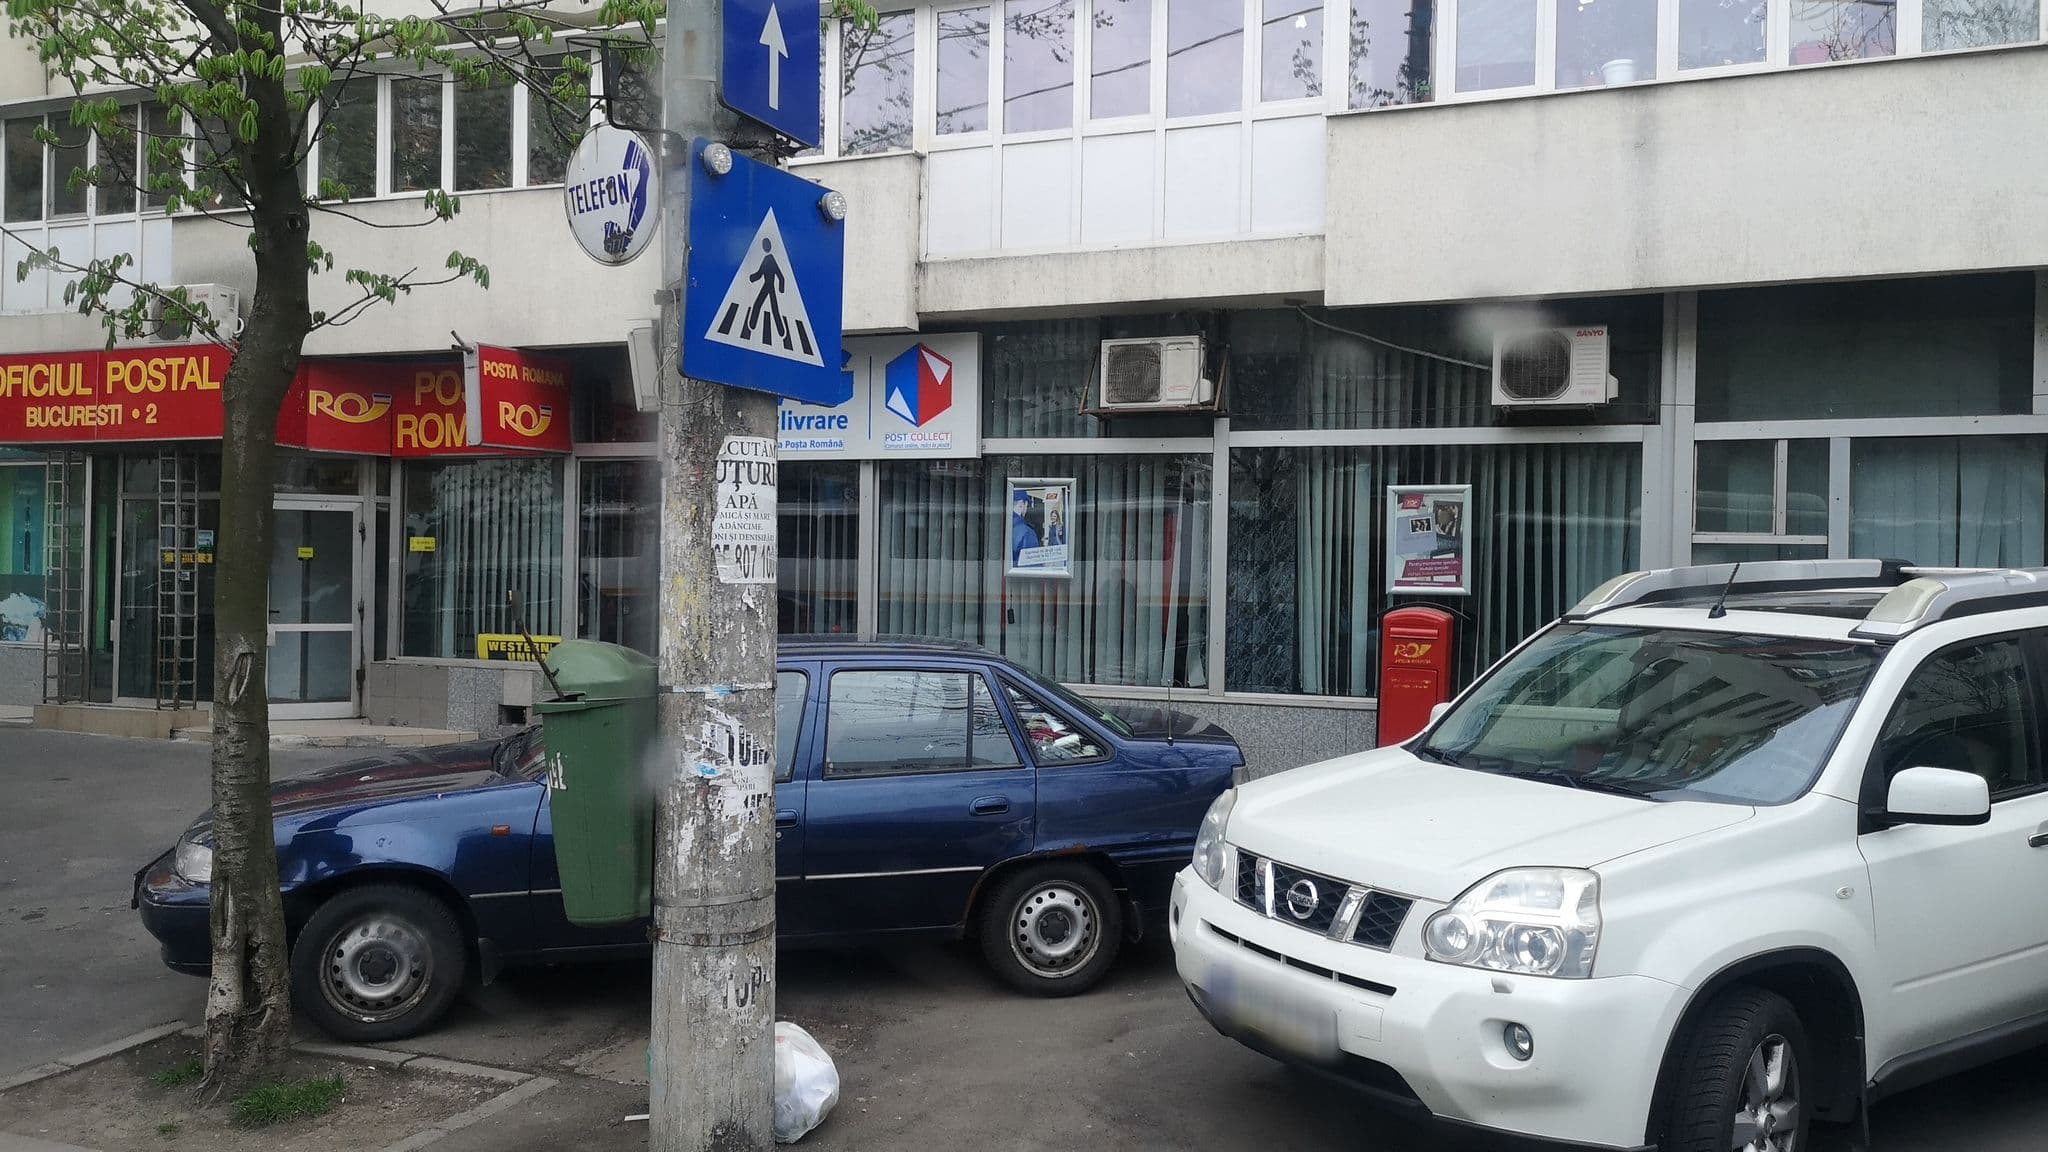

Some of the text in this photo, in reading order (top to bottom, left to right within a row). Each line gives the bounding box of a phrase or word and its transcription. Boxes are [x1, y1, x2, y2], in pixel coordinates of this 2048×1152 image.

[568, 172, 630, 216] TELEFON
[1576, 329, 1604, 337] SANYO
[106, 356, 220, 394] POSTAL
[483, 360, 518, 380] POSTA
[415, 370, 466, 406] PO
[26, 403, 158, 428] BUCURESTI 2
[781, 410, 848, 430] livrare
[885, 432, 950, 442] POST COLLECT
[725, 493, 758, 509] APĂ
